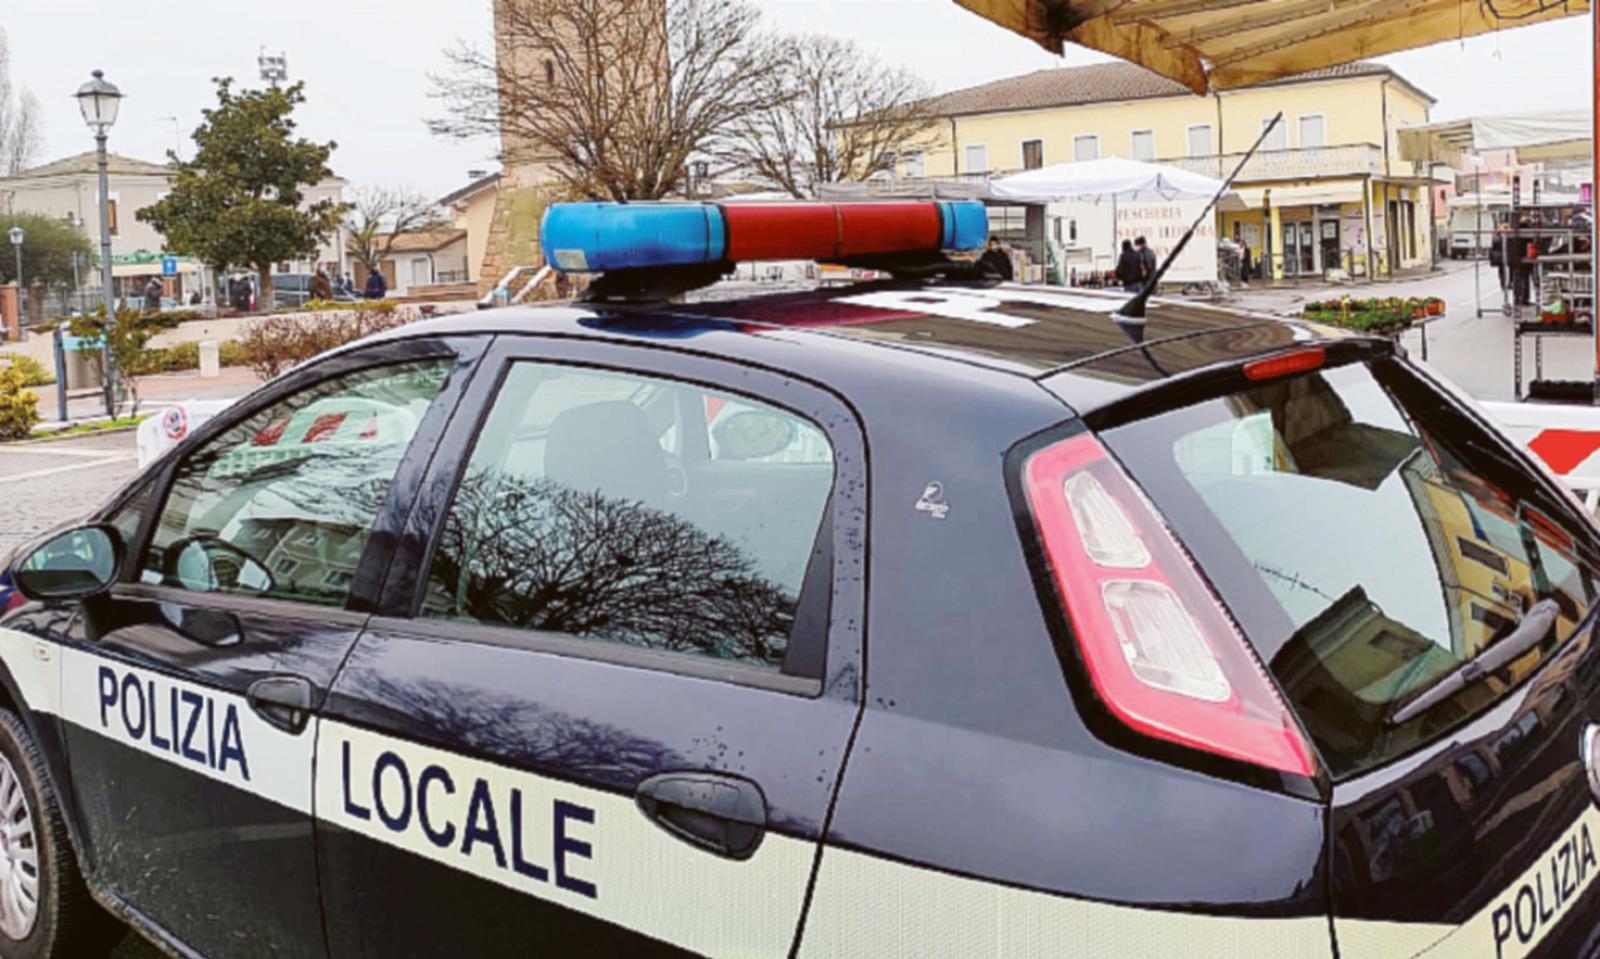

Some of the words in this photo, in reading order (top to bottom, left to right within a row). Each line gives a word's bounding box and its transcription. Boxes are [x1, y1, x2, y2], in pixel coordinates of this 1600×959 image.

[99, 667, 250, 781] POLIZIA
[342, 741, 598, 899] LOCALE
[1491, 822, 1597, 959] POLIZIA
